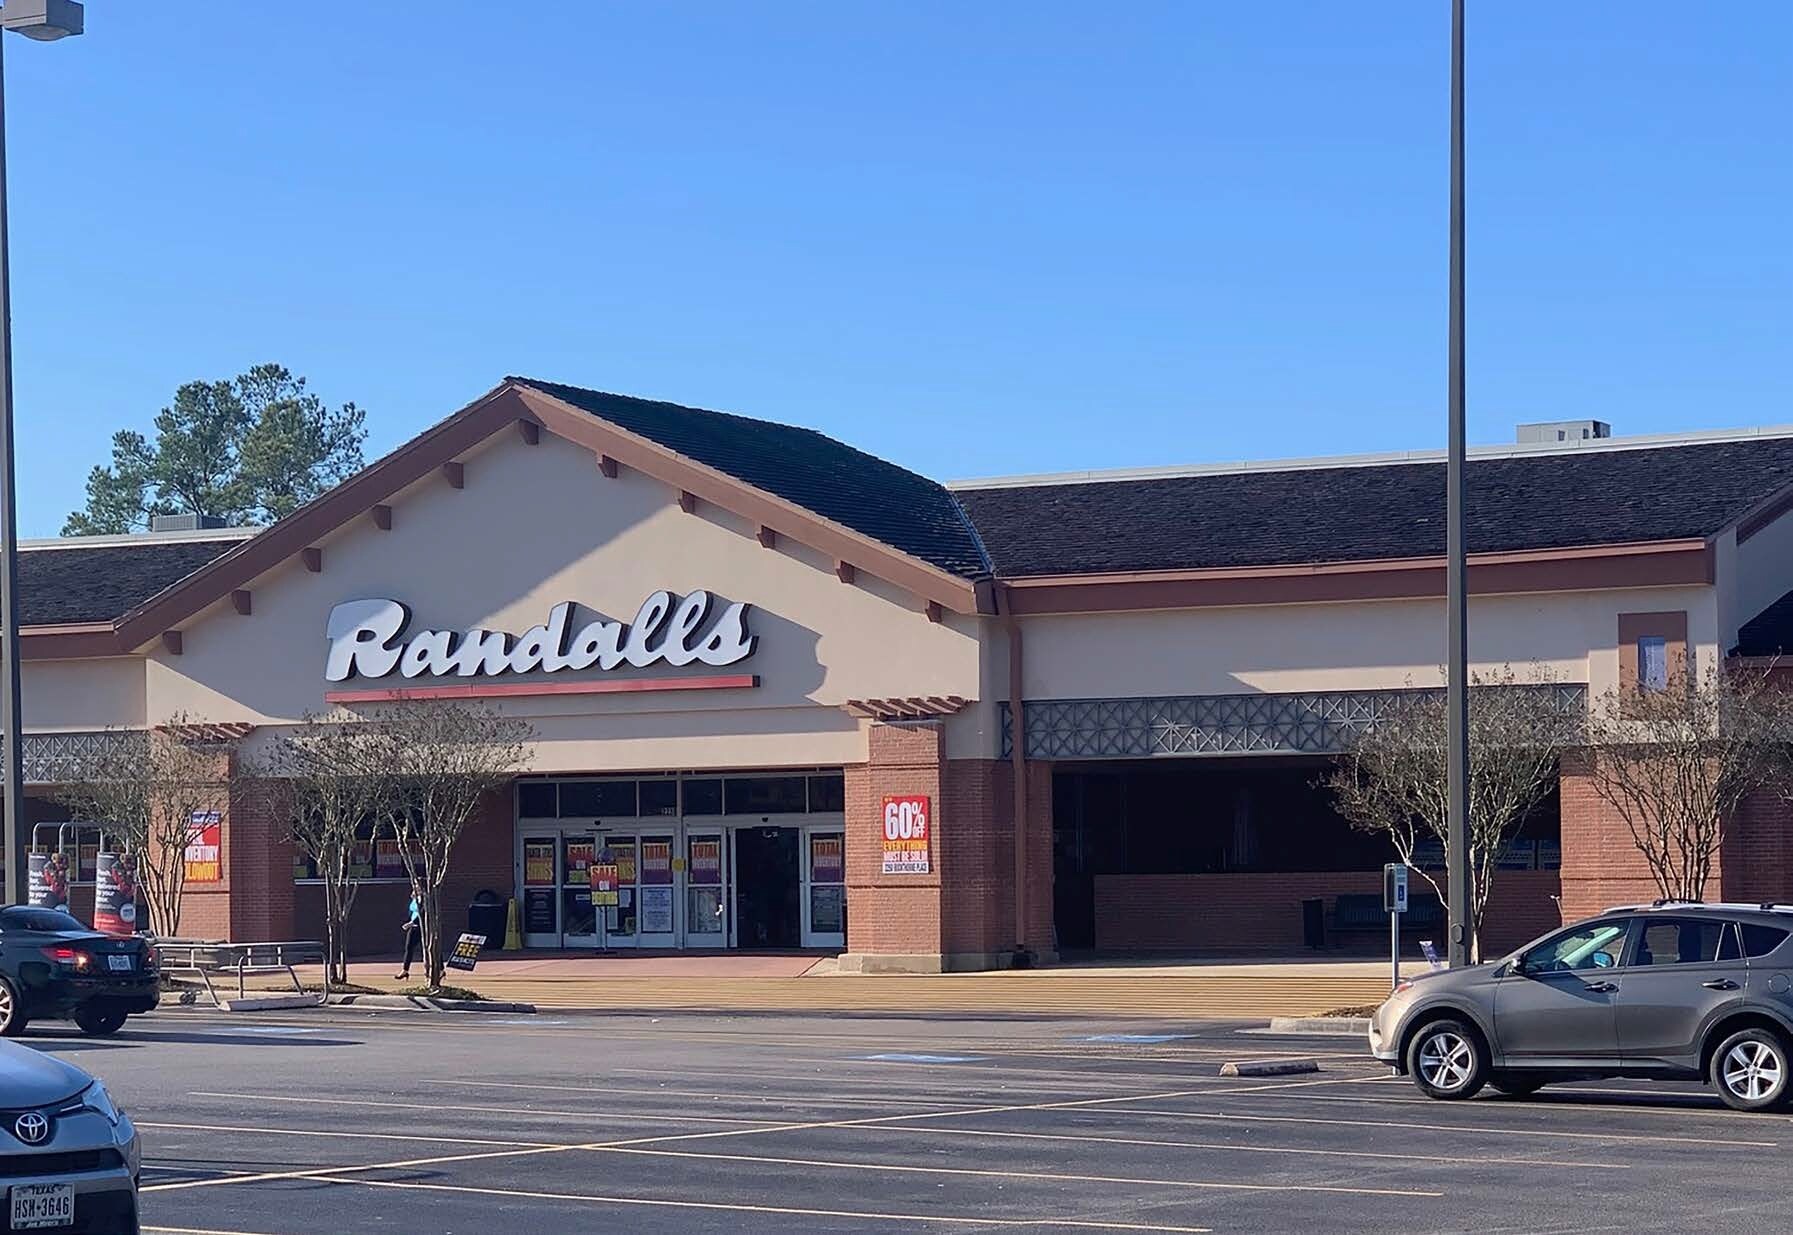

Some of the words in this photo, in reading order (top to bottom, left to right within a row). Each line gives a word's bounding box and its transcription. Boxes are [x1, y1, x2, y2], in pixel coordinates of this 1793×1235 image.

[325, 590, 756, 682] Randalls
[885, 801, 925, 840] 60%
[884, 841, 927, 851] EVERYTHING
[185, 846, 219, 862] NVENTORY
[592, 867, 616, 879] SALE
[455, 943, 480, 958] FREE
[31, 1184, 55, 1195] TEXAS
